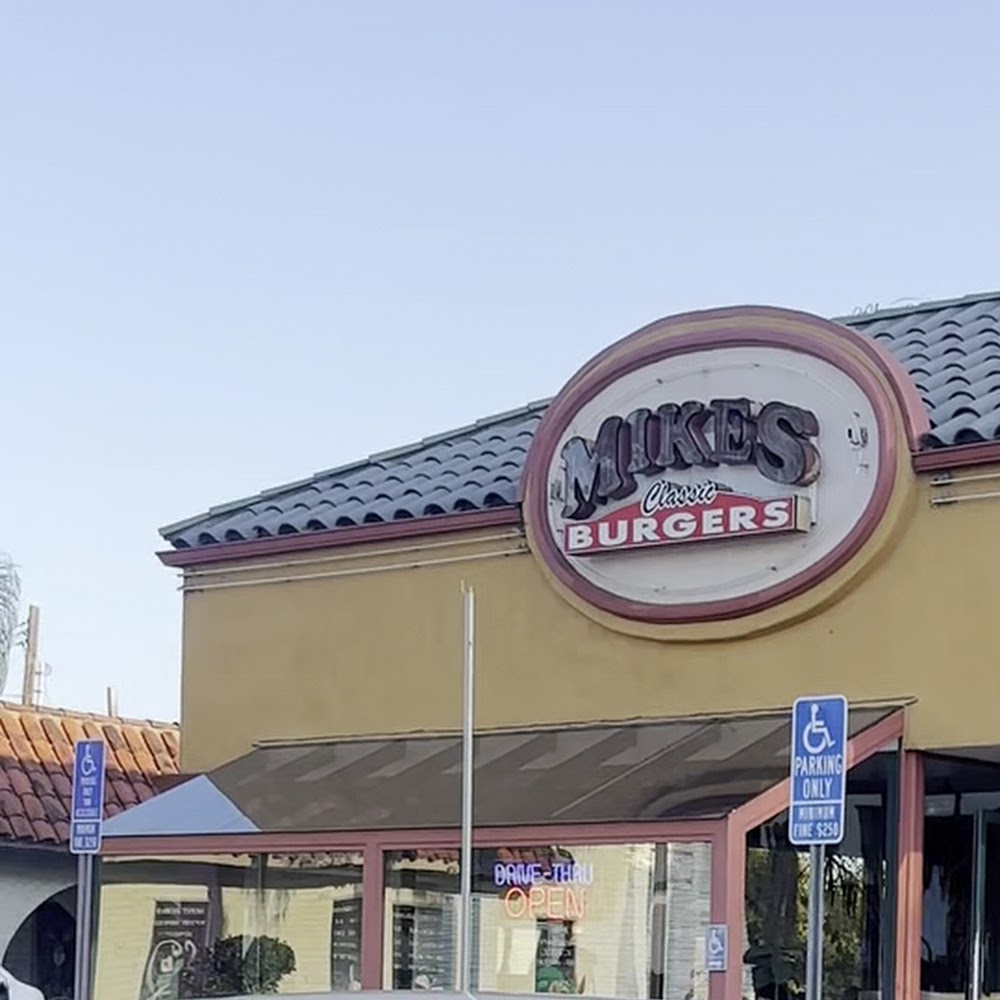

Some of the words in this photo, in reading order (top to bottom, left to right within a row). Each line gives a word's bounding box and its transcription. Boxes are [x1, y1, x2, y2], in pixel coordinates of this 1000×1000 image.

[641, 479, 718, 516] Classic
[568, 502, 790, 550] BURGERS
[795, 754, 842, 776] PARKING
[803, 777, 832, 799] ONLY
[794, 823, 812, 838] FINE
[816, 821, 839, 838] $250
[494, 862, 593, 886] DRIVE-THRU
[505, 887, 585, 918] OPEN
